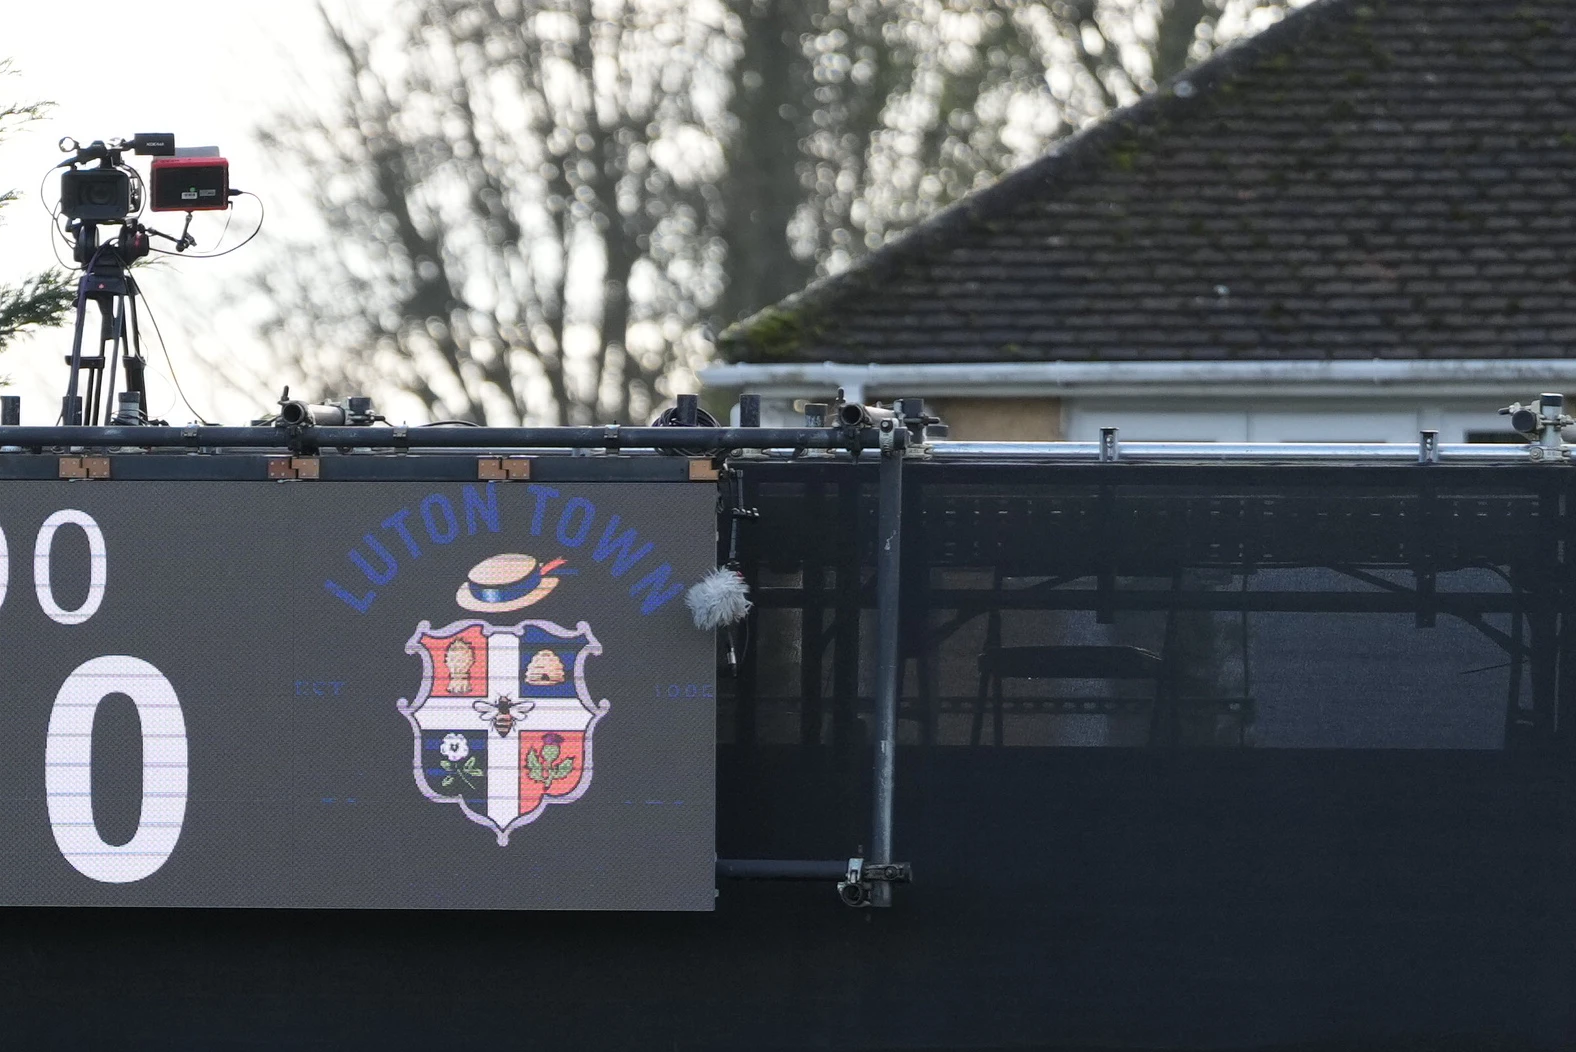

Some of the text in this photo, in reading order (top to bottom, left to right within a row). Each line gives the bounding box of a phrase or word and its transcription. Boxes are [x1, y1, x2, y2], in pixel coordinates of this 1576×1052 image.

[324, 483, 686, 616] LUTON TOWN
[44, 655, 189, 884] 0
